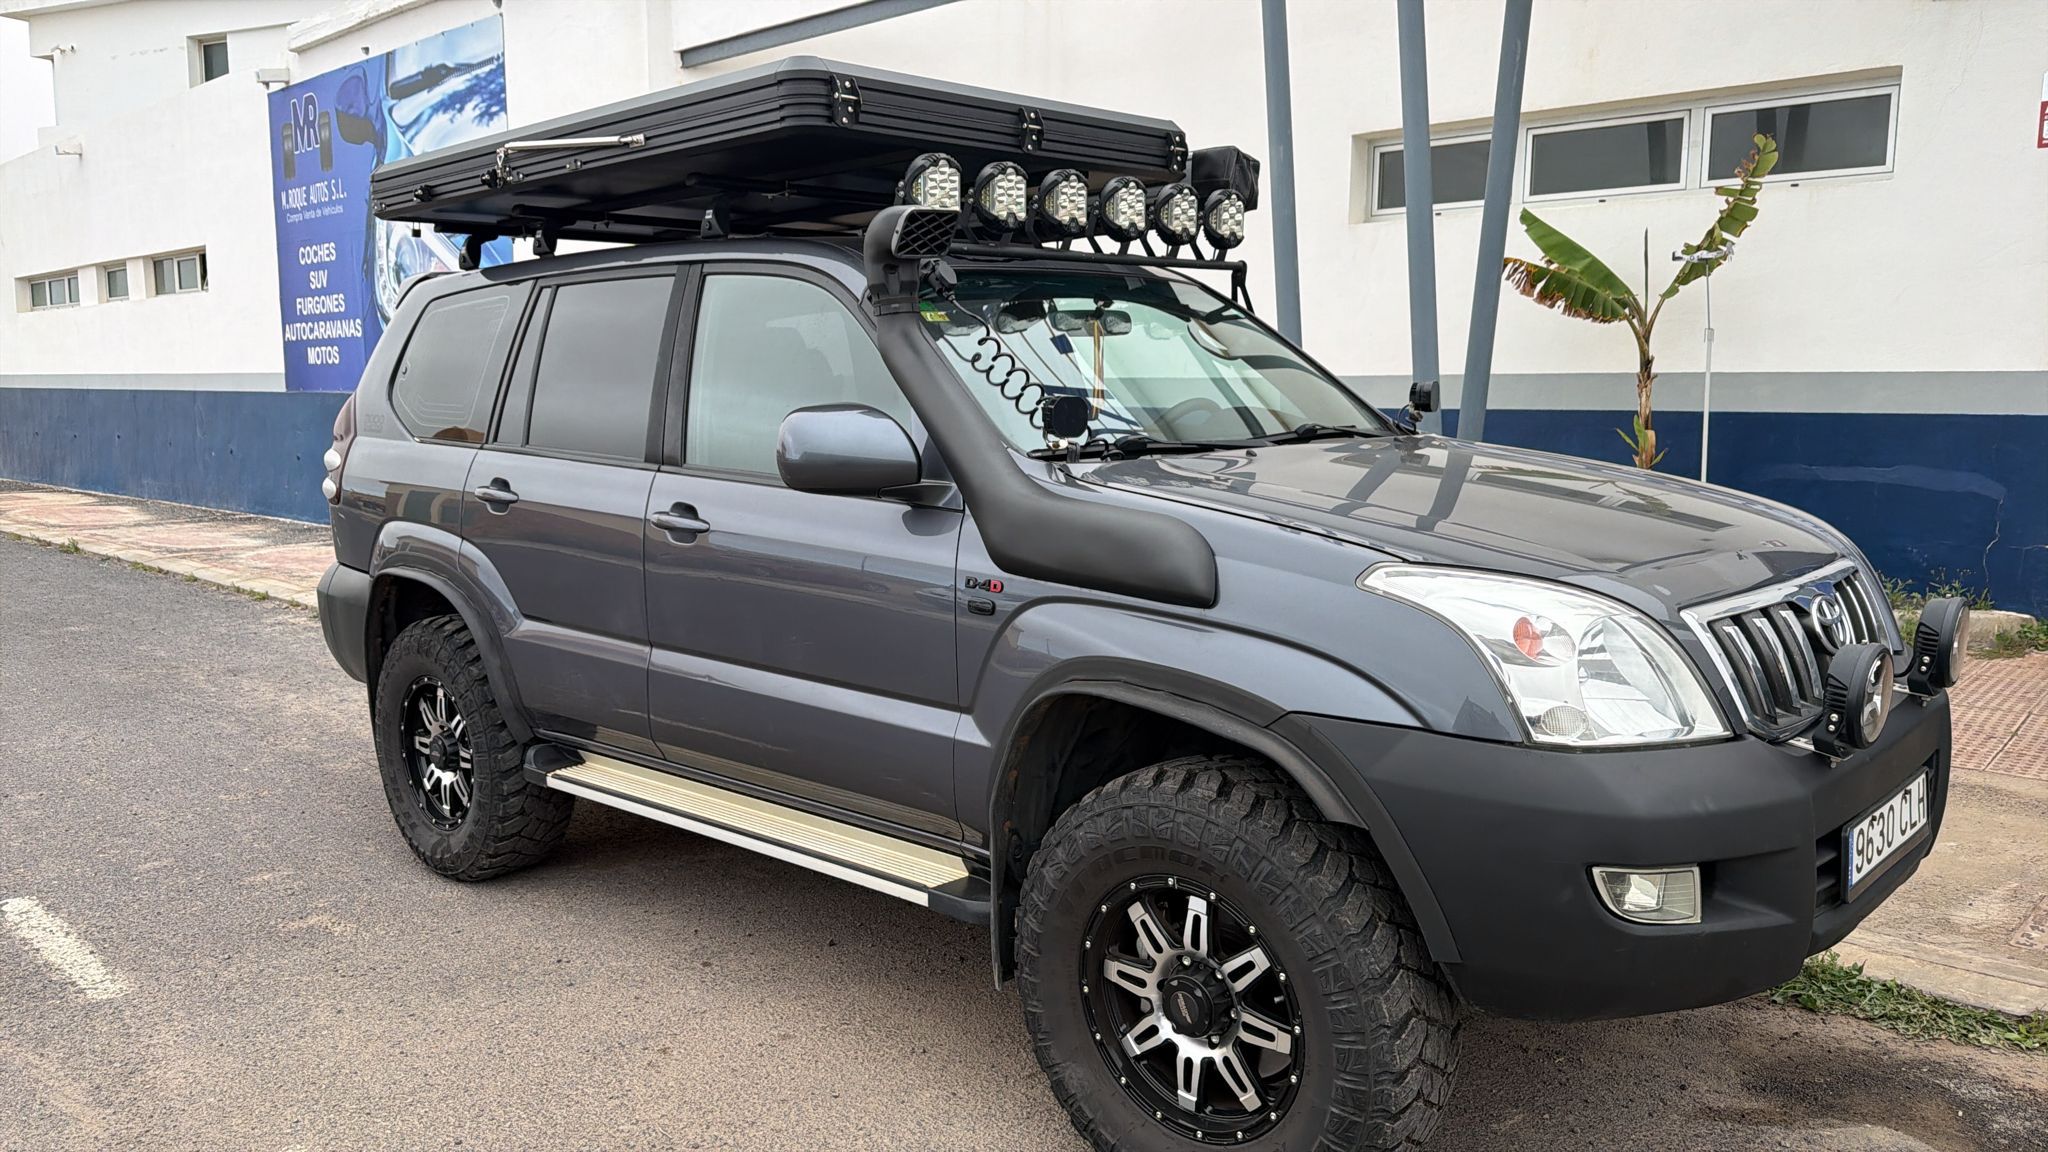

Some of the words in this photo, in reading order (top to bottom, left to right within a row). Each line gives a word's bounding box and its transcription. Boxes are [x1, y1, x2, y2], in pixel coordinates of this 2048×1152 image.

[290, 92, 320, 155] MR
[309, 180, 329, 204] AUTOS
[331, 177, 347, 200] S.L.
[299, 242, 336, 265] COCHES
[309, 269, 328, 289] SUV
[296, 293, 345, 316] FURGONES
[285, 319, 362, 341] AUTOCARAVANAS
[307, 346, 340, 365] MOTOS
[1855, 804, 1895, 874] 9630
[1899, 777, 1925, 836] CLH
